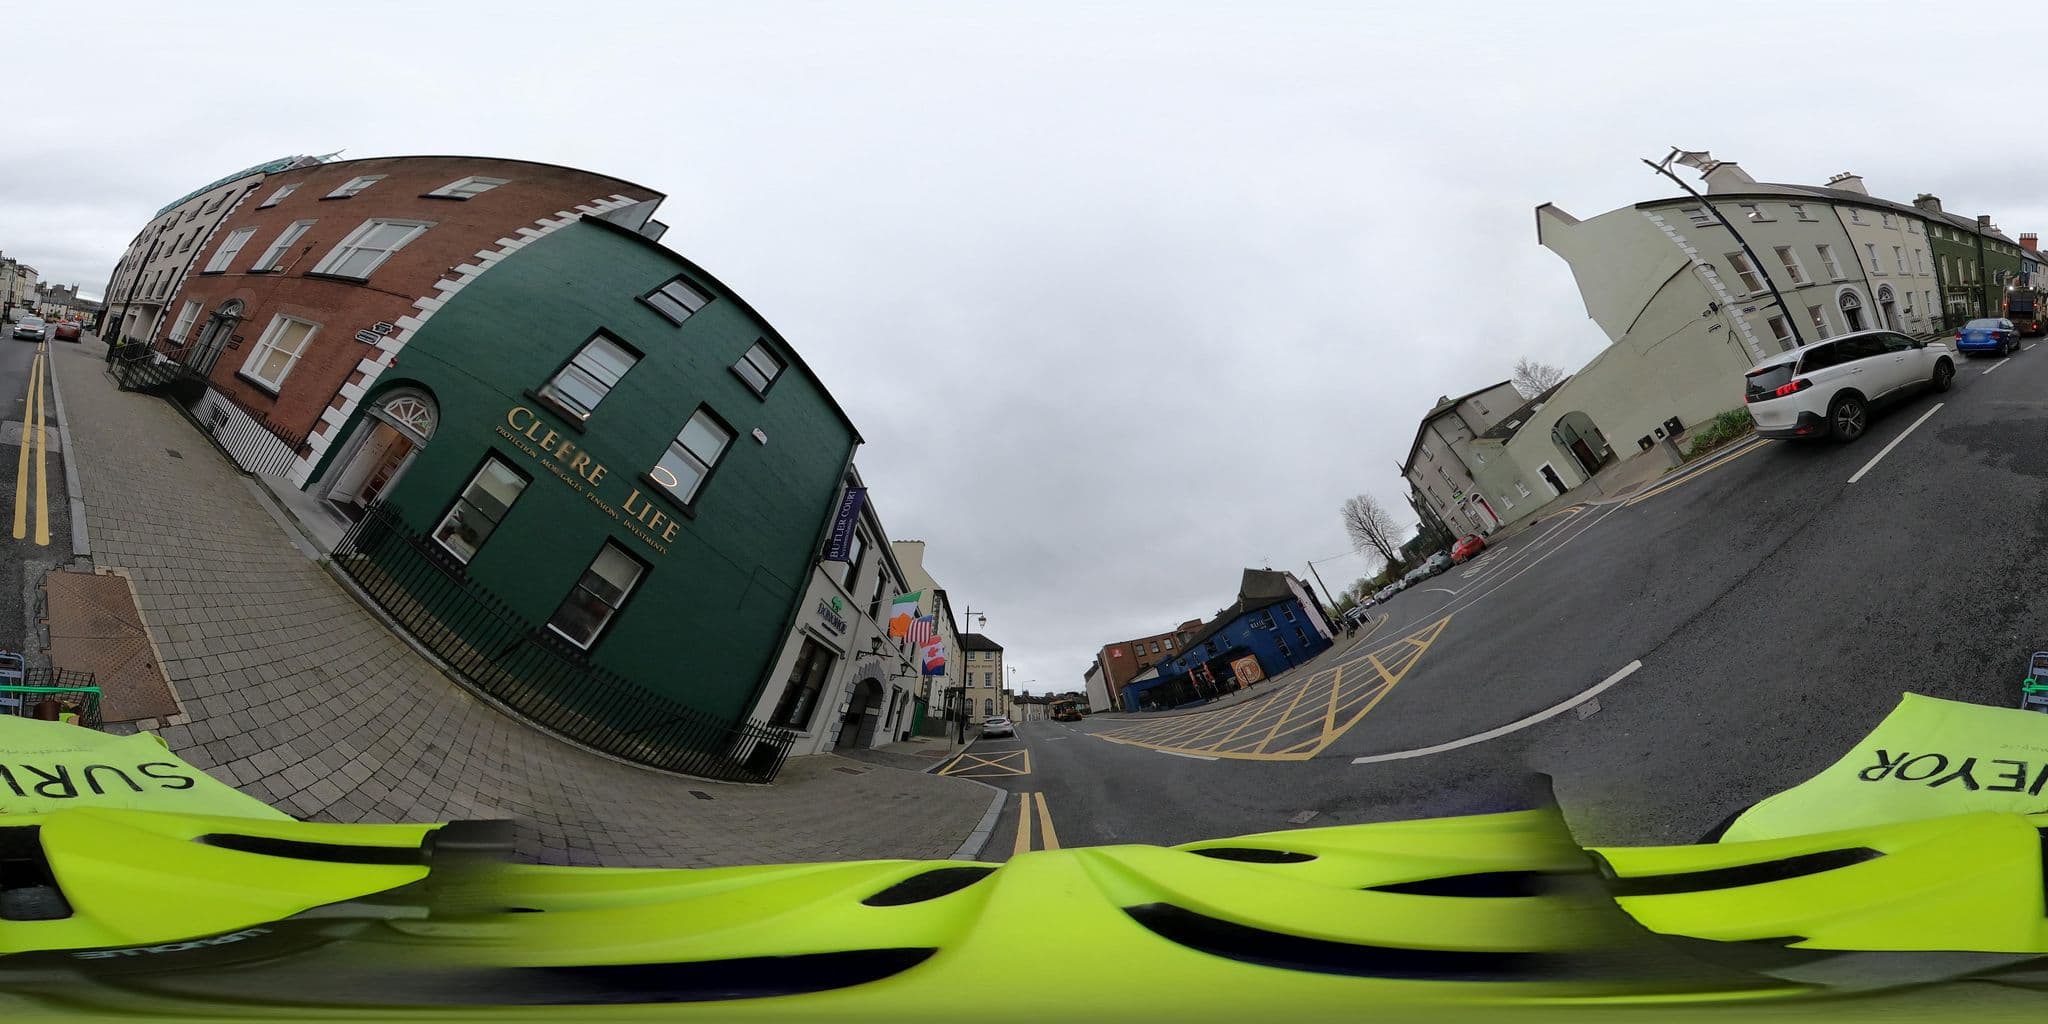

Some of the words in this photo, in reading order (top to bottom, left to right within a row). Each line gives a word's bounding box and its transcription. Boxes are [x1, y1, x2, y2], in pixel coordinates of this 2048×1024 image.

[496, 425, 537, 458] PROTECTION
[586, 491, 620, 521] PENSIONS
[623, 520, 668, 554] INVESTMENTS
[507, 406, 608, 487] CLEERE
[622, 488, 681, 543] LIFE
[829, 519, 847, 558] BUTLER
[840, 490, 857, 519] COURT
